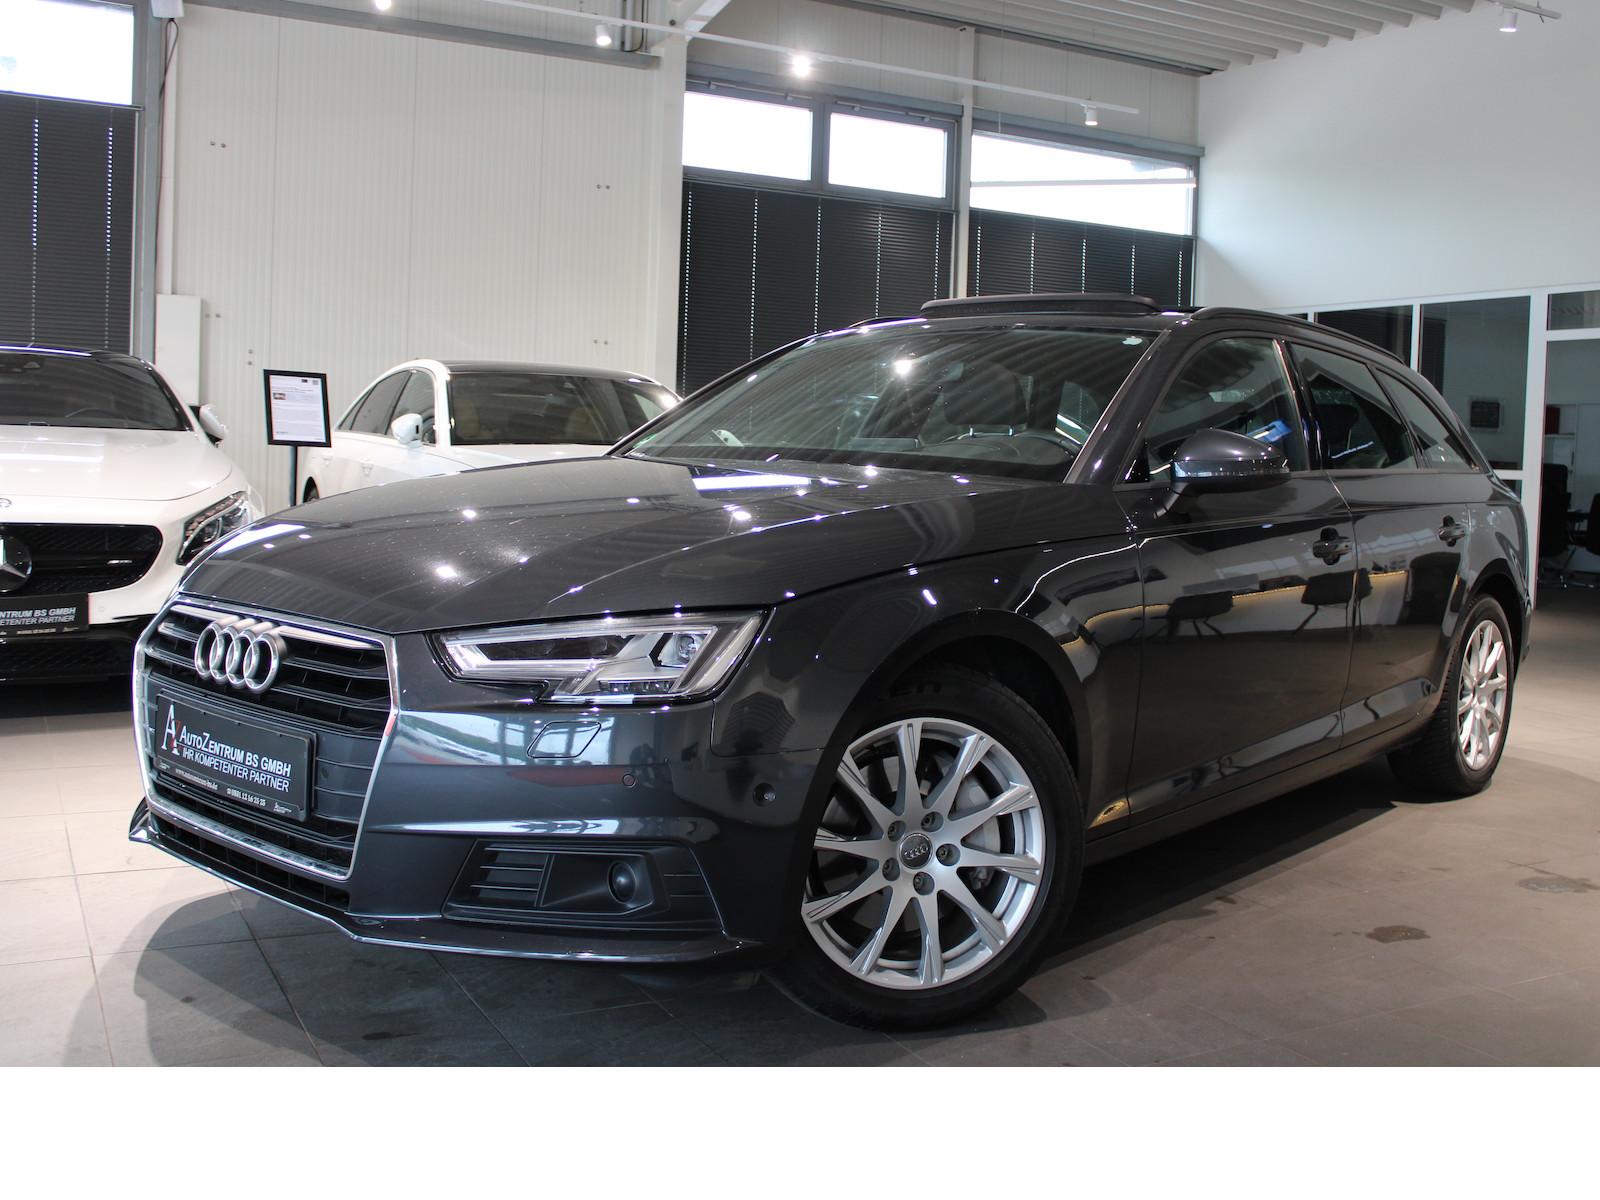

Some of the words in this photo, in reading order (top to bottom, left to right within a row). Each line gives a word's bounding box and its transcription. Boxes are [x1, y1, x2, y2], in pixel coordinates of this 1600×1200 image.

[33, 609, 47, 617] BS
[49, 606, 77, 616] GMBH
[38, 615, 75, 624] PARTNER
[182, 746, 195, 761] IHR
[195, 751, 249, 780] KOMPETENTER
[249, 769, 289, 793] PARTNER
[245, 751, 259, 768] BS
[260, 756, 292, 777] GMBH
